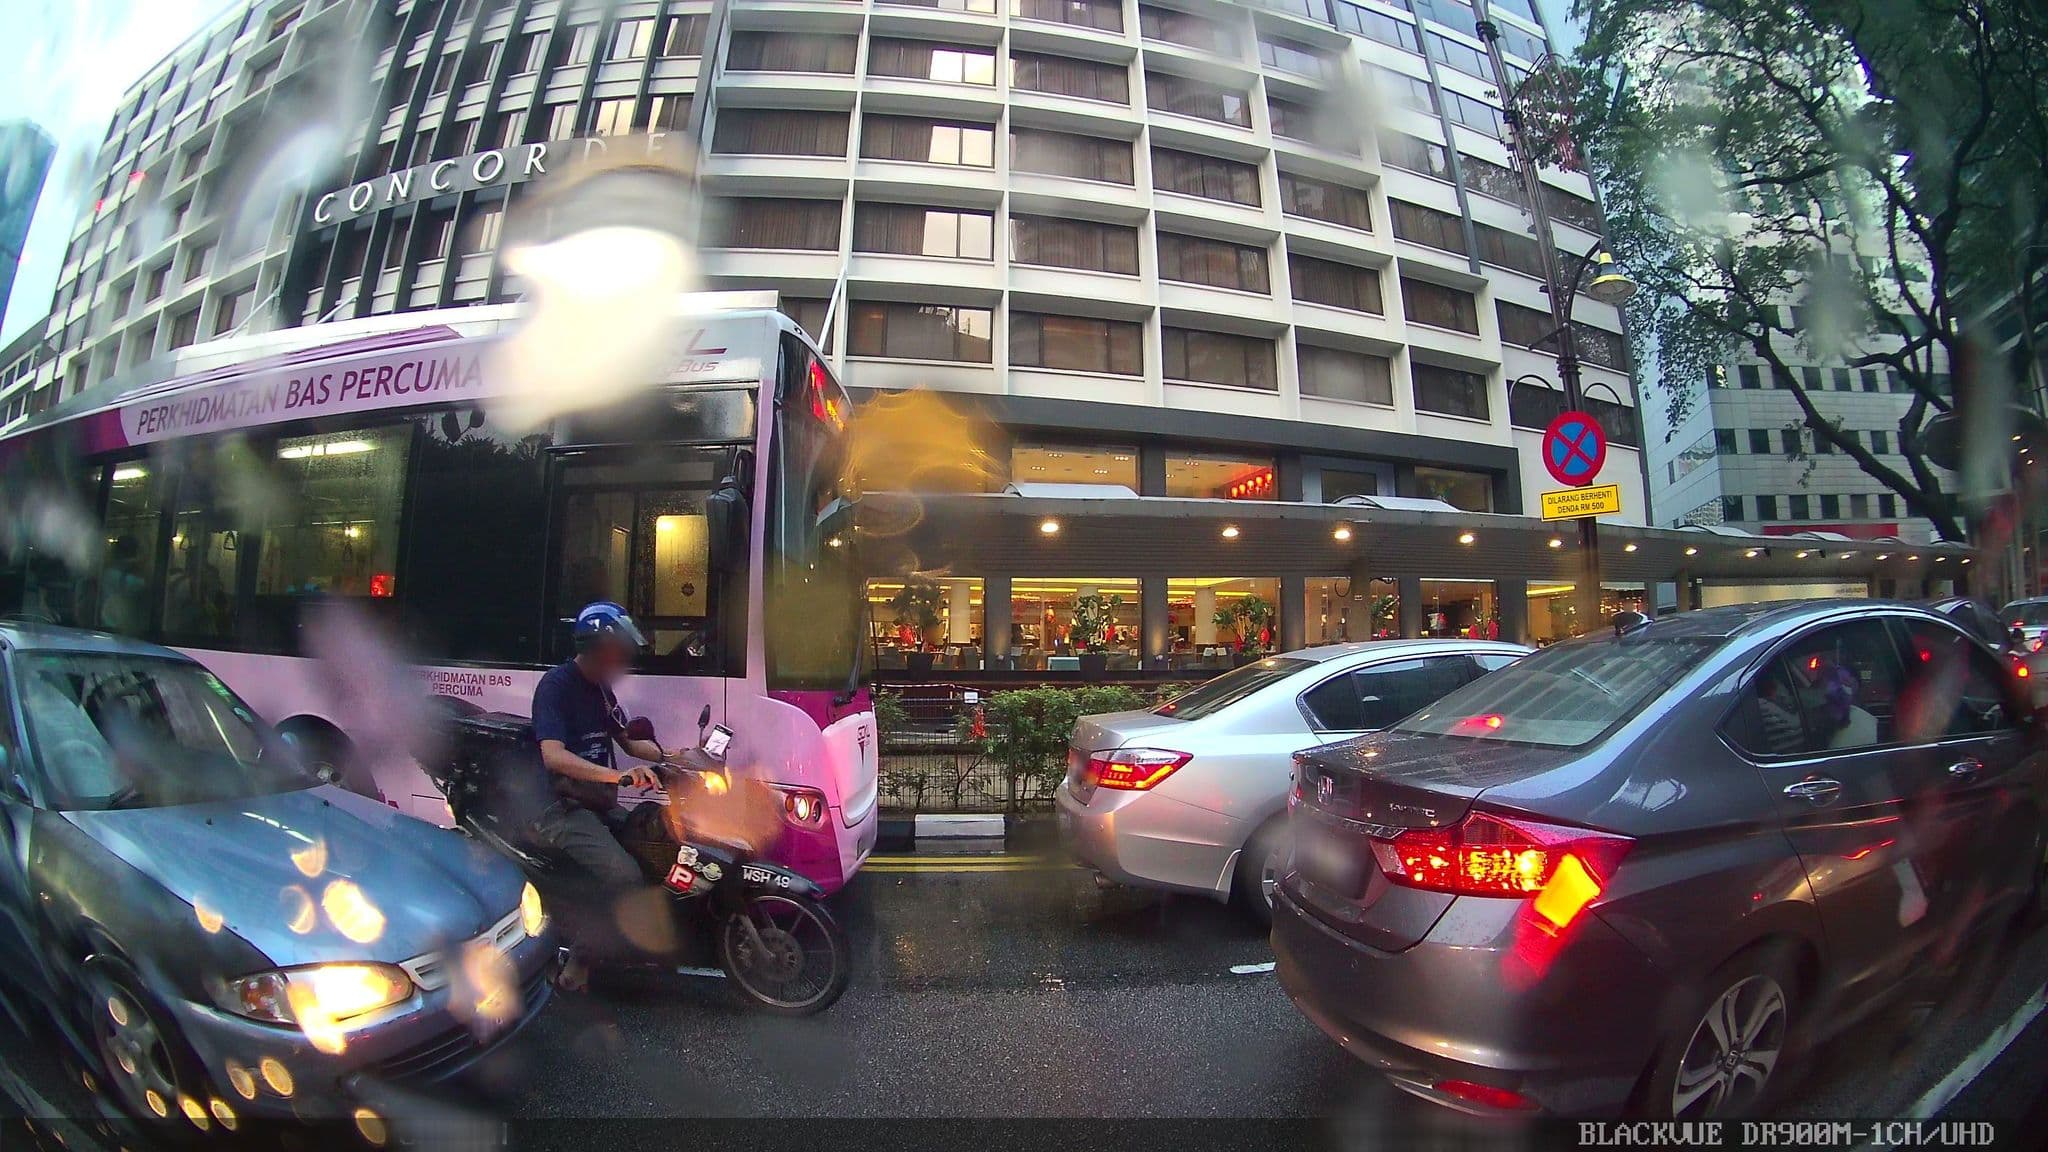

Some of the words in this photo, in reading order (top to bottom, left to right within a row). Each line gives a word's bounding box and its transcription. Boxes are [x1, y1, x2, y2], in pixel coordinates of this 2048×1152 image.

[136, 383, 281, 436] PERKHIDMATAN
[285, 374, 333, 409] BAS
[340, 355, 483, 401] PERCUMA
[1548, 494, 1580, 505] DILARANG
[1581, 490, 1612, 501] BERHENTI
[1558, 505, 1579, 513] DENDA
[1581, 503, 1590, 511] RM
[1592, 501, 1604, 510] 500
[489, 675, 512, 687] BAS
[433, 683, 483, 697] PERCUMA
[670, 866, 693, 884] P
[743, 868, 771, 883] WSH
